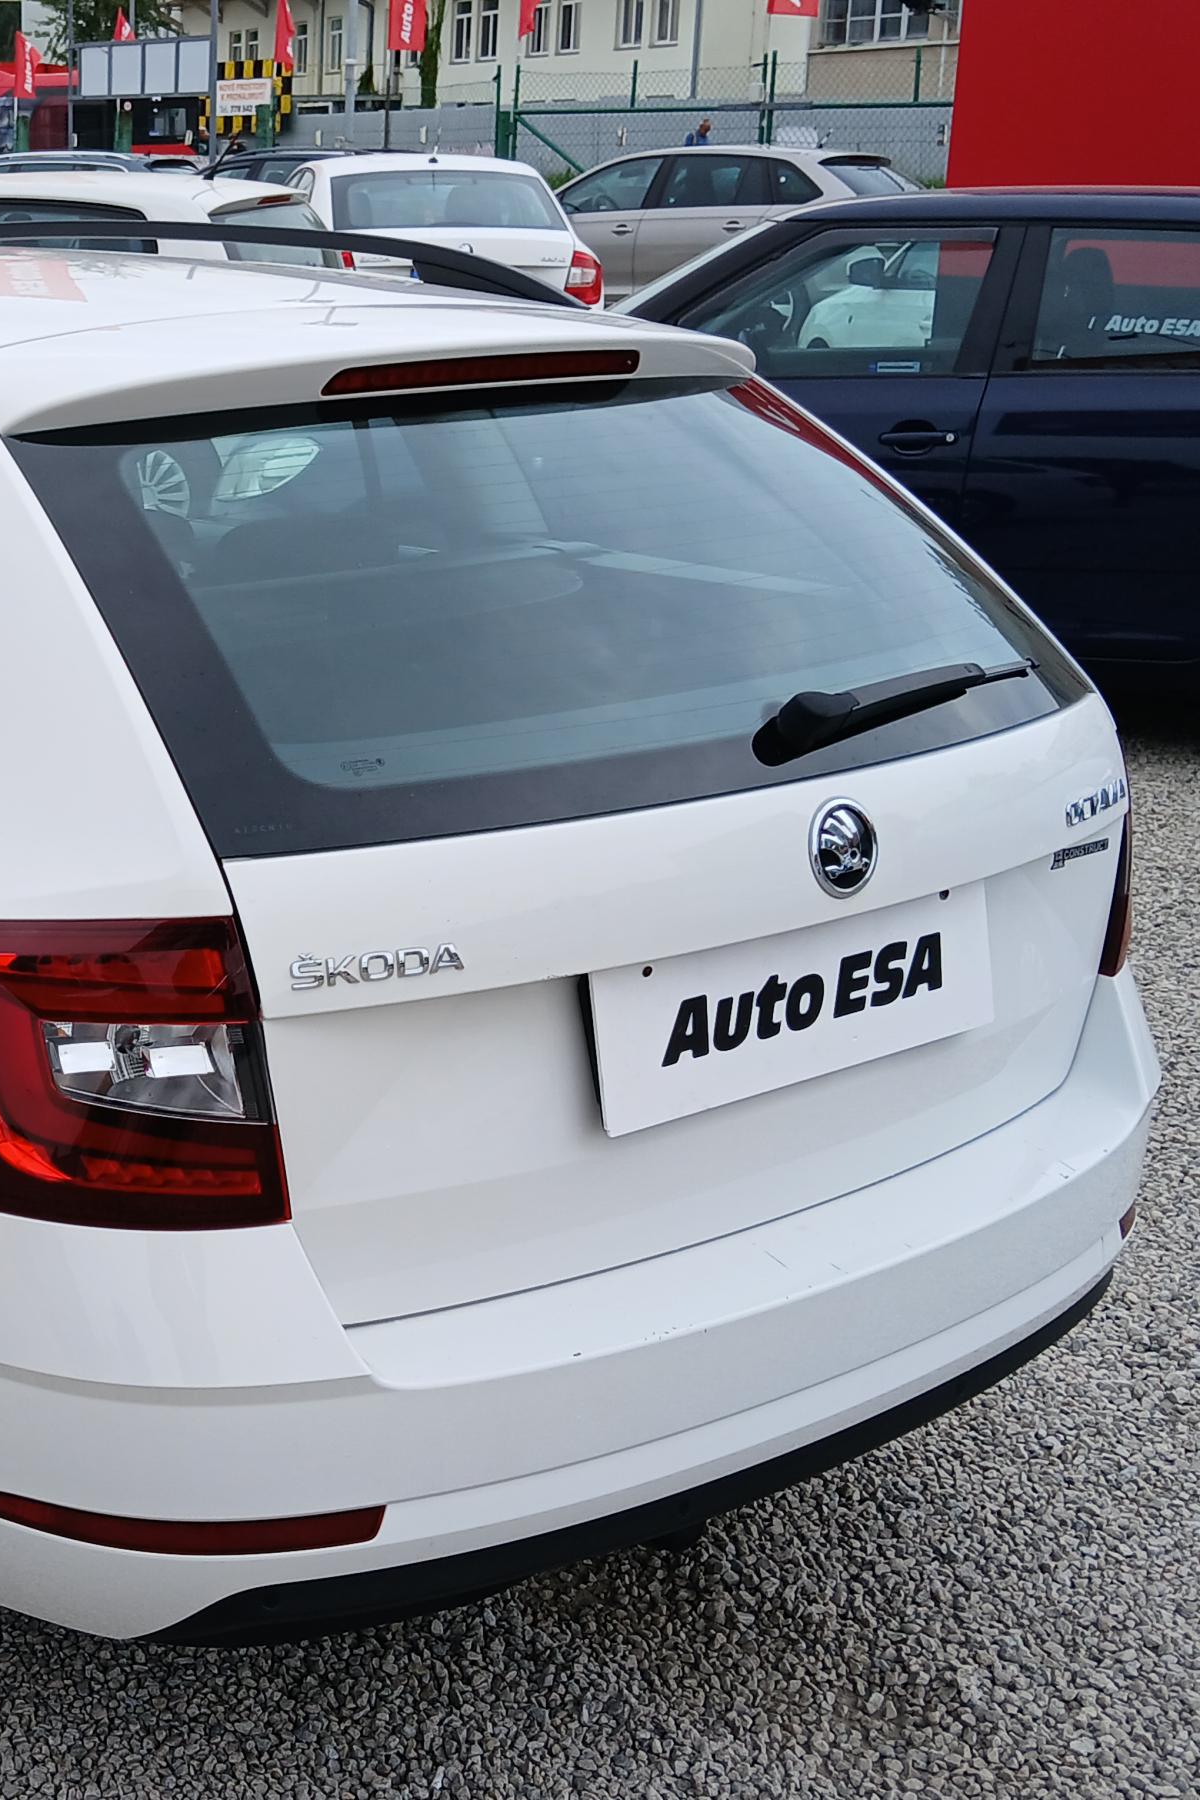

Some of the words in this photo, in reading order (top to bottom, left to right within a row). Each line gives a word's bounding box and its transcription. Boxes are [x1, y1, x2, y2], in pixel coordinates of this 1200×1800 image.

[400, 4, 414, 45] Auto
[1104, 314, 1160, 335] Auto
[1160, 318, 1200, 337] ESA
[1063, 839, 1109, 861] CONSTRUCT
[290, 942, 465, 991] ŠKODA
[661, 974, 825, 1068] Auto
[833, 931, 943, 1019] ESA
